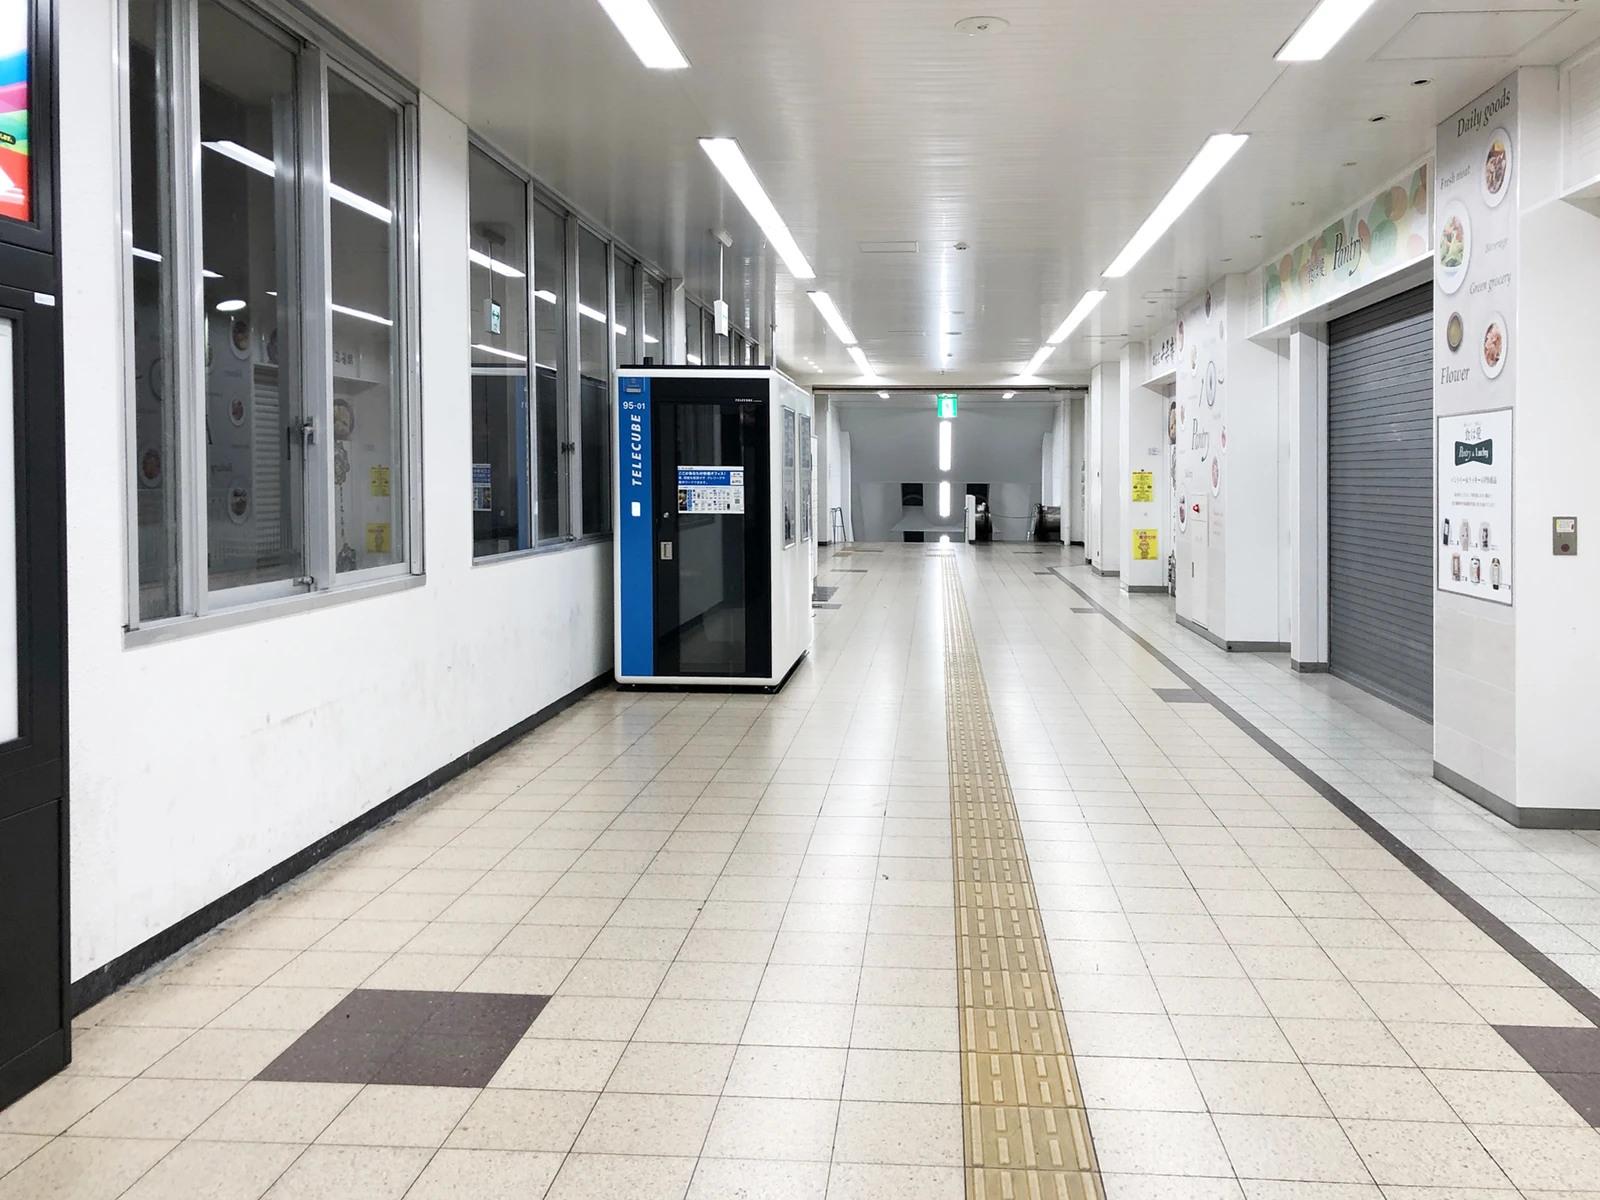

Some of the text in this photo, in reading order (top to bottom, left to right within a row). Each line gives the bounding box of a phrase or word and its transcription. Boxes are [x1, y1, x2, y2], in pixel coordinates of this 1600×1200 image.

[1456, 88, 1511, 138] Daily goods
[1440, 172, 1455, 190] Fresh
[1333, 232, 1363, 277] Pantry
[1469, 271, 1512, 295] Green grocery
[1440, 364, 1470, 385] Flower
[622, 401, 646, 410] 95-01
[631, 414, 642, 486] TELECUBE
